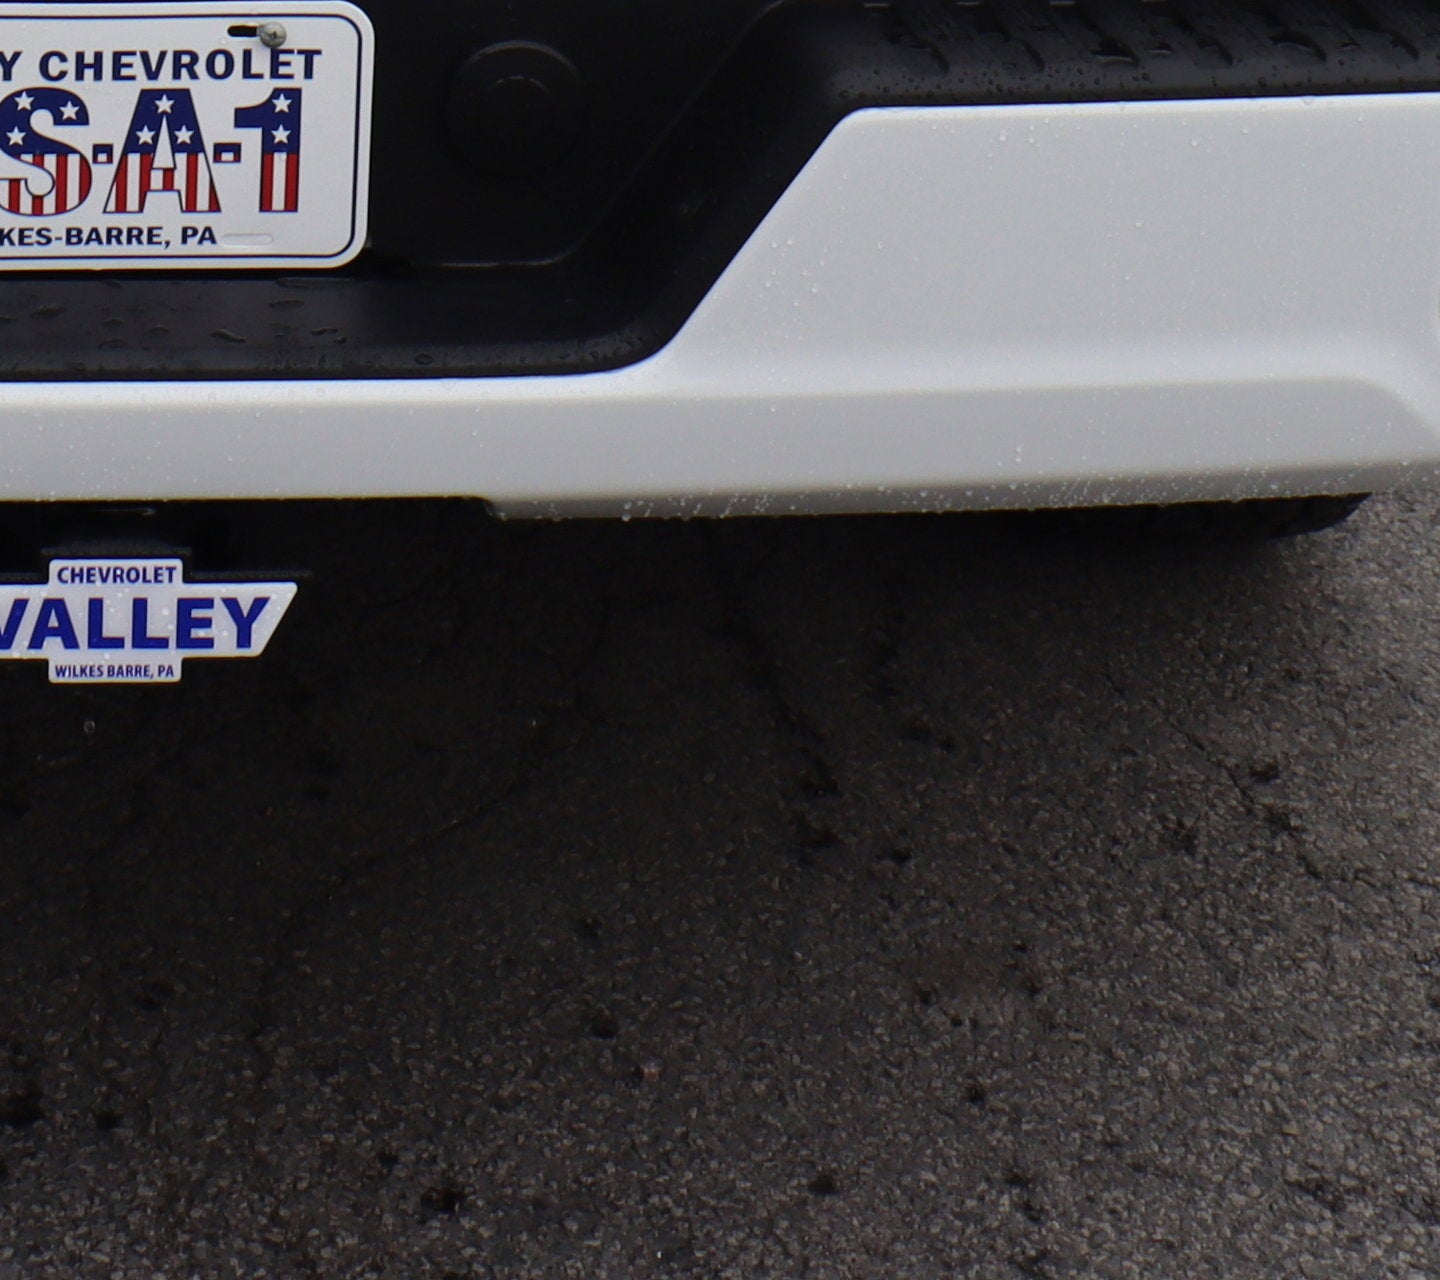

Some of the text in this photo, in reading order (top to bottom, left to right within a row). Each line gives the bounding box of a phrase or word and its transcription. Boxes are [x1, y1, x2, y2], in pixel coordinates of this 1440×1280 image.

[39, 48, 322, 81] CHEVROLET
[180, 226, 218, 246] PA
[56, 566, 177, 584] CHEVROLET
[54, 664, 175, 681] WILKES BARRE, PA
